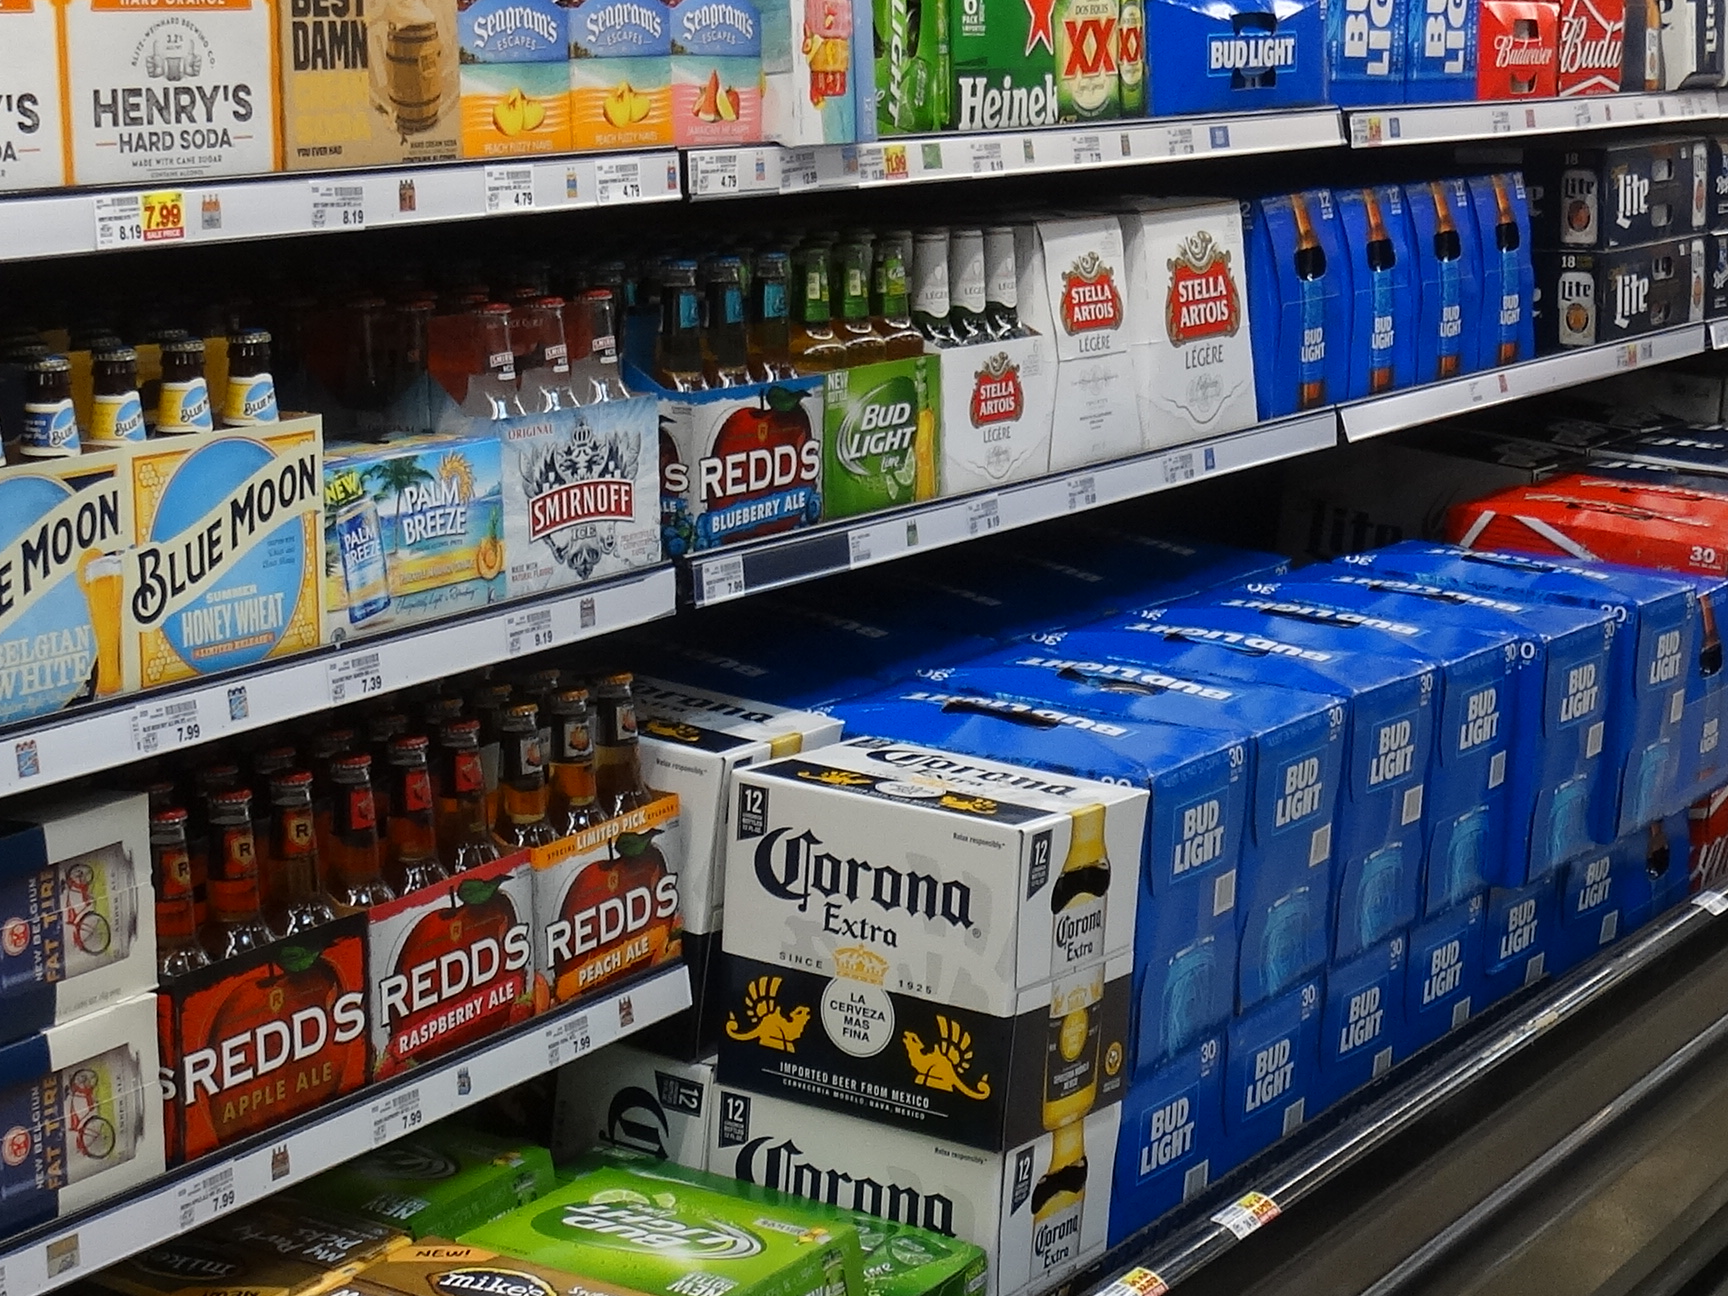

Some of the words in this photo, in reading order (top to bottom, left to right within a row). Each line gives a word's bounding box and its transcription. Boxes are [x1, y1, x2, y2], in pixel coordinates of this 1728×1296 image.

[472, 6, 559, 50] Seagram's
[1063, 18, 1119, 79] XX
[1178, 279, 1228, 302] STELLA
[1179, 301, 1231, 325] ARTOIS
[1183, 343, 1224, 370] LÉGÈRE
[404, 478, 461, 512] PALM
[530, 483, 633, 533] SMIRNOFF
[710, 500, 782, 532] BLUEBERRY
[785, 492, 807, 513] ALE
[131, 528, 224, 626] BLUE
[230, 455, 316, 548] MOON
[402, 505, 466, 545] BREEZE
[360, 676, 383, 694] 7.39
[1182, 800, 1222, 842] BUD
[1173, 825, 1227, 875] LIGHT
[753, 825, 976, 929] Corona
[822, 904, 898, 950] Extra
[577, 951, 618, 986] PEACH
[621, 939, 650, 966] ALE
[778, 951, 824, 970] SINCE
[849, 992, 866, 1005] LA
[897, 978, 933, 995] 1925
[398, 1000, 483, 1053] RASPBERRY
[487, 982, 516, 1011] ALE
[829, 1000, 886, 1023] CERVEZA
[842, 1015, 870, 1031] MAS
[841, 1026, 870, 1043] FINA
[222, 1083, 287, 1125] APPLE
[294, 1061, 333, 1093] ALE
[779, 1059, 831, 1083] IMPORTED
[832, 1071, 858, 1092] BEER
[860, 1078, 888, 1099] FROM
[891, 1085, 930, 1110] MEXICO
[212, 1190, 236, 1212] 7.99
